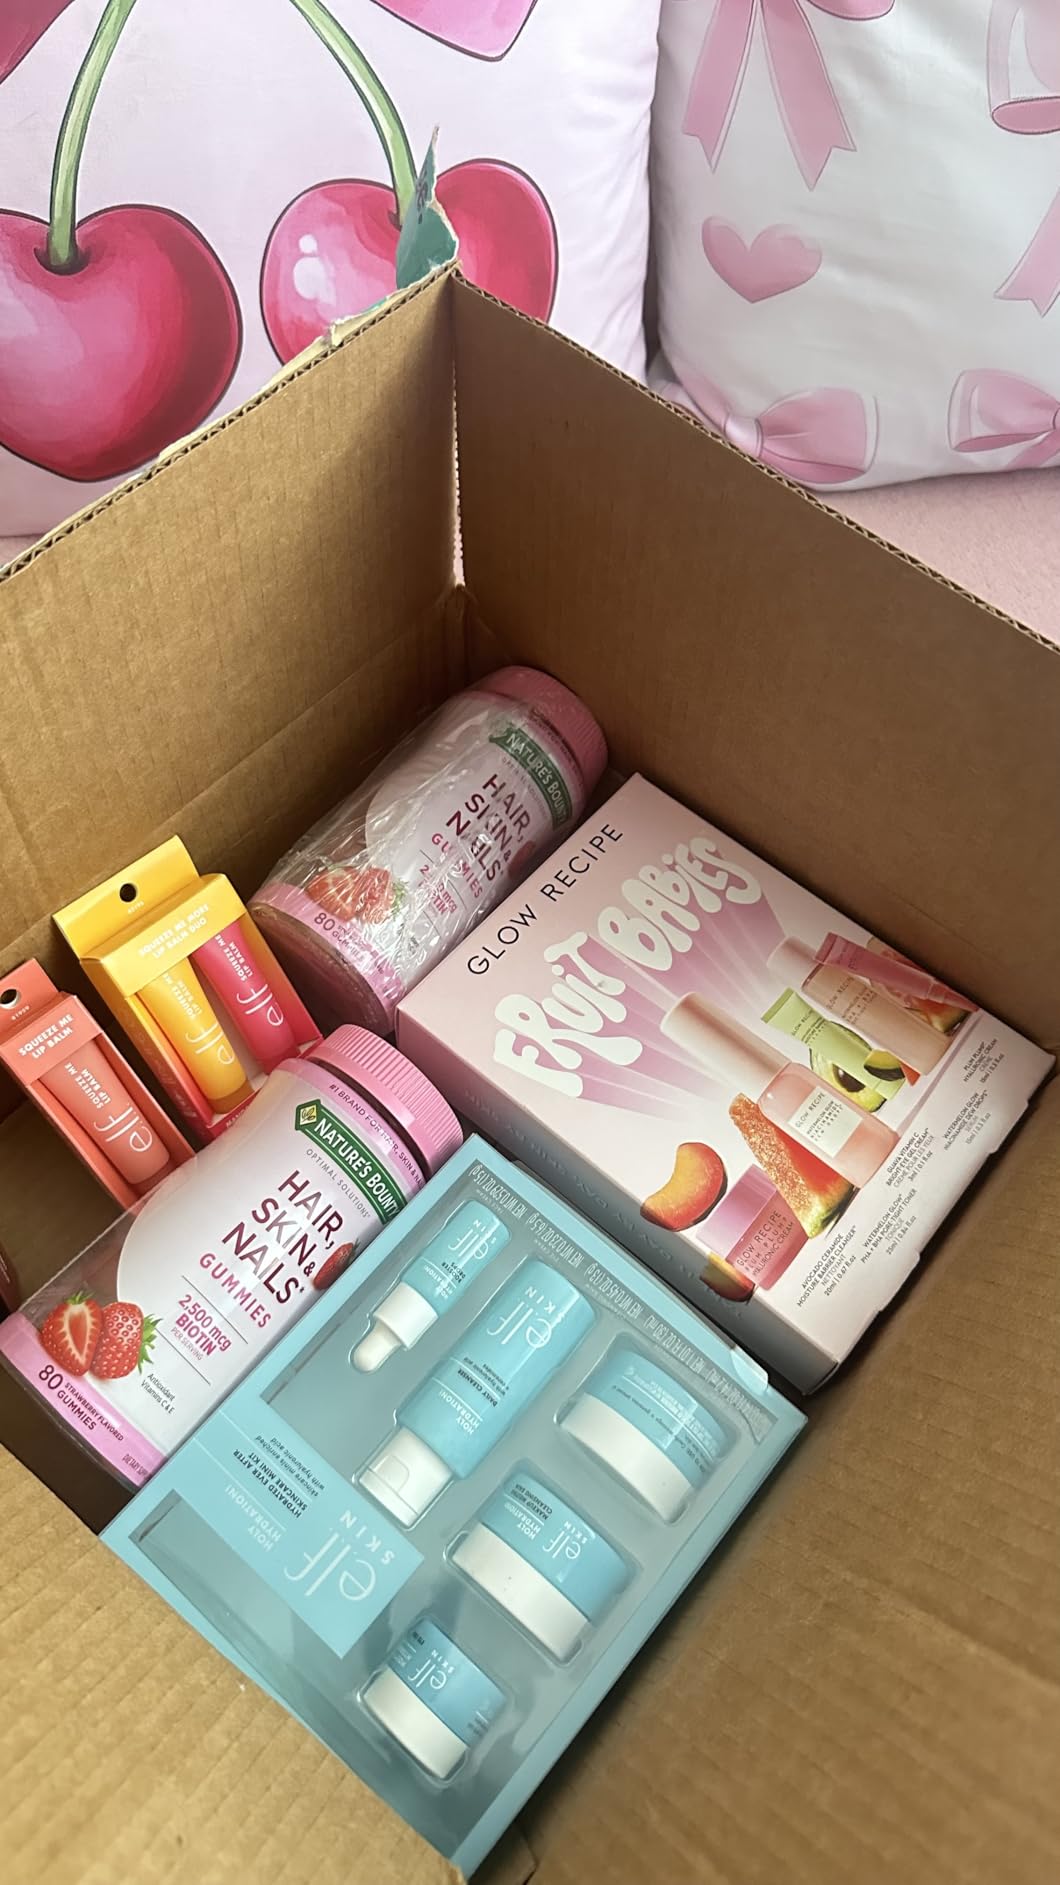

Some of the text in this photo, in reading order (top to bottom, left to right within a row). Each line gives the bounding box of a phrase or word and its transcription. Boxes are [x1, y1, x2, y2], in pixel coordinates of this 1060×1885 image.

[504, 732, 556, 784] NATURE'S
[481, 773, 534, 843] HAIR,
[463, 903, 540, 979] GLOW
[540, 820, 624, 905] RECIPE
[312, 910, 337, 933] 80
[214, 933, 248, 981] SQUEEZE ME
[228, 940, 254, 977] LIP BALM
[18, 1013, 73, 1056] SQUEEZE ME
[30, 1026, 73, 1059] LIP BALM
[63, 1061, 104, 1109] SQUEEZE ME
[80, 1067, 111, 1104] LIP BALM
[808, 1091, 825, 1111] RECIPE
[328, 1082, 340, 1093] #1
[336, 1089, 366, 1116] BRAND
[364, 1114, 383, 1132] FOR
[397, 1151, 413, 1170] SKIN
[942, 1091, 979, 1139] WATERMELON GLOW
[964, 1106, 977, 1120] DEW
[304, 1147, 339, 1180] OPTIMAL
[312, 1116, 402, 1218] NATURE'S BOUNTY
[886, 1135, 916, 1173] GUAVA VITAMIN
[906, 1147, 917, 1159] GEL
[467, 1161, 528, 1218] NET WT 0.529 OZ (15 g)
[276, 1168, 348, 1250] HAIR,
[860, 1250, 872, 1263] PHA
[871, 1234, 884, 1248] BHA
[901, 1187, 917, 1206] TONER
[248, 1194, 320, 1278] SKIN &
[524, 1209, 584, 1267] NET WT 0.23 OZ (6.5 g)
[736, 1209, 781, 1267] GLOW RECIPE
[776, 1220, 795, 1244] CREAM
[862, 1212, 891, 1248] WATERMELON
[440, 1261, 463, 1283] BOOSTER
[449, 1261, 466, 1278] DROPS
[588, 1267, 606, 1286] (13
[800, 1233, 844, 1289] AVOCADO CERAMIDE
[820, 1253, 846, 1286] NETTOYANT
[196, 1250, 273, 1329] GUMMIES
[598, 1276, 613, 1293] OZ
[605, 1282, 626, 1304] 0.45
[796, 1276, 820, 1307] MOISTURE
[816, 1254, 836, 1279] BARRIER
[823, 1265, 848, 1296] 20ml 0.67
[617, 1293, 634, 1311] WT
[626, 1300, 644, 1319] NET
[174, 1312, 218, 1356] BIOTIN
[177, 1293, 233, 1353] 2,500 mcg
[661, 1331, 677, 1348] OZ
[170, 1326, 204, 1361] PER SERVING
[36, 1362, 66, 1392] 80
[456, 1367, 498, 1407] DAILY CLEANSER
[55, 1388, 97, 1431] GUMMIES
[63, 1381, 124, 1442] STRAWBERRY FLAVORED
[159, 1399, 168, 1407] C
[167, 1406, 175, 1414] E
[454, 1415, 475, 1434] HOLY
[246, 1450, 309, 1510] SKINCARE MINI KIT
[254, 1433, 320, 1497] skincare minis enriched
[269, 1436, 325, 1491] with hyaluronic acid
[231, 1448, 302, 1518] HYDRATED EVER AFTER
[223, 1482, 282, 1542] HYDRATION!
[525, 1499, 549, 1520] MAKEUP
[245, 1522, 275, 1551] HOLY
[337, 1508, 396, 1565] SKIN
[515, 1520, 537, 1540] HOLY
[542, 1530, 582, 1560] elf
[562, 1520, 588, 1544] SKIN
[405, 1653, 447, 1690] elf
